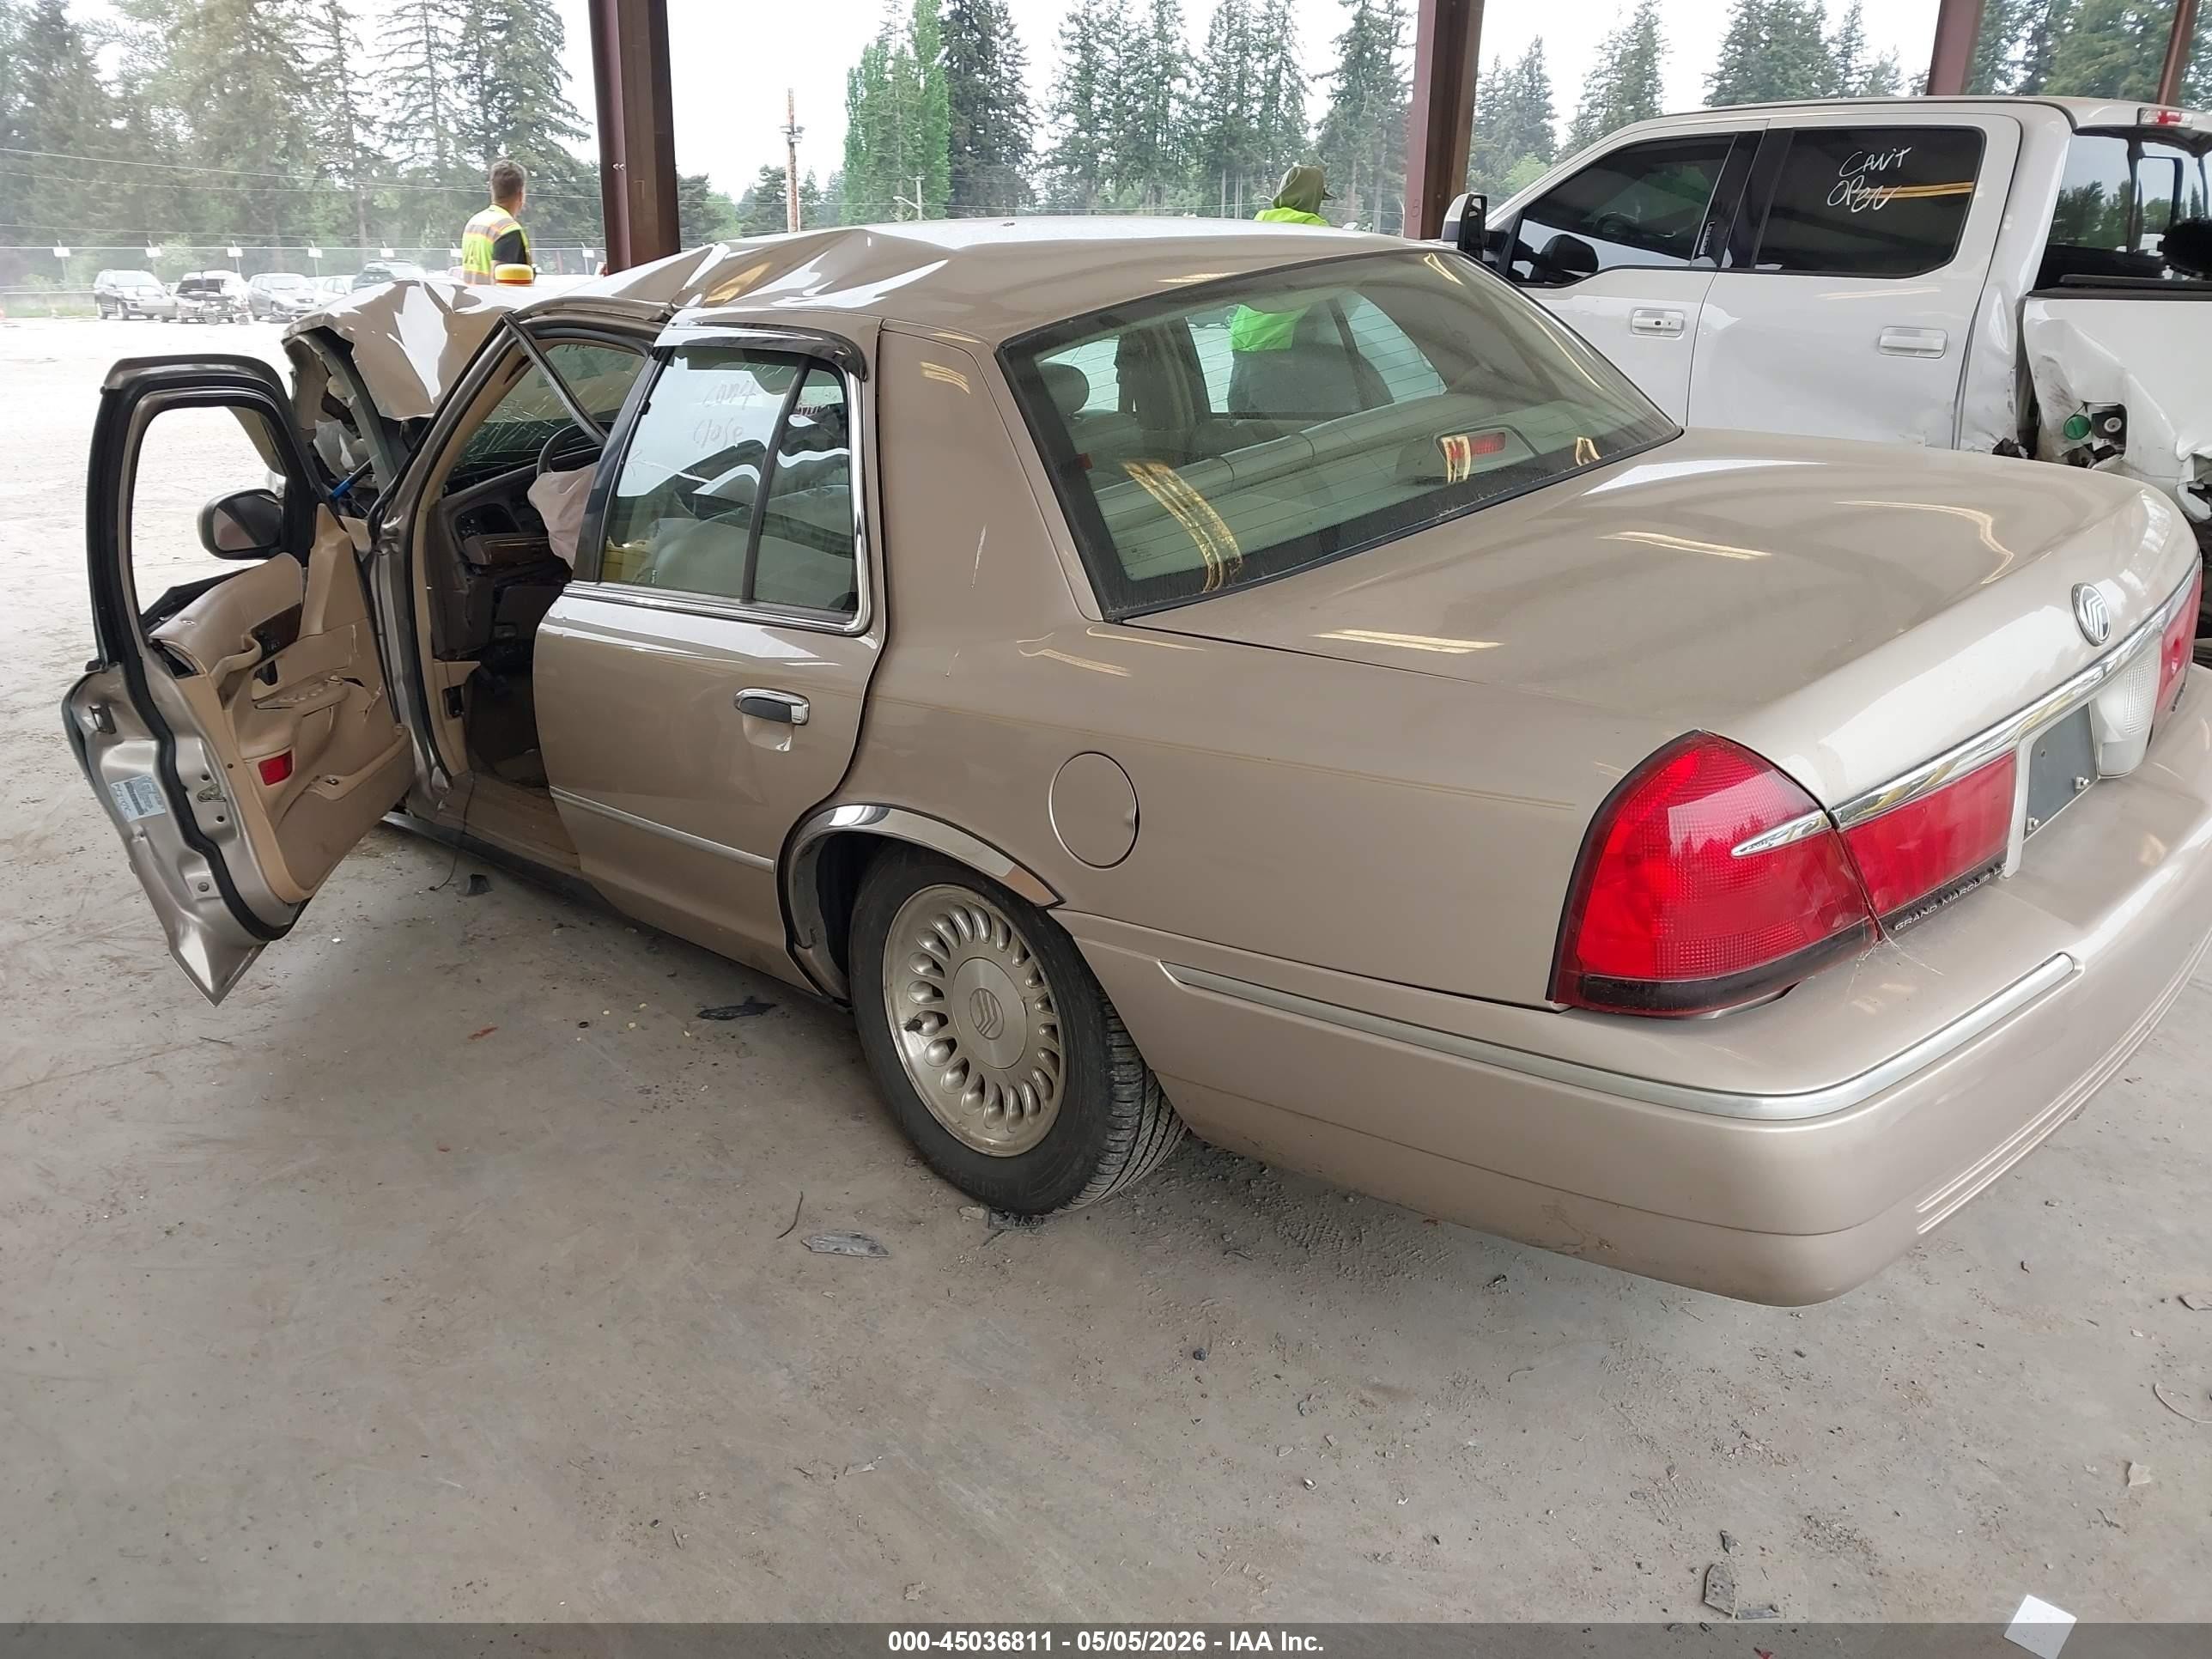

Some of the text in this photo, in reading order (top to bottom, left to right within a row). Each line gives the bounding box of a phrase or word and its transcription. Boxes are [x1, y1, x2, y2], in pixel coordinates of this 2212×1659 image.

[1839, 147, 1912, 177] CAN'T
[1827, 175, 1902, 213] OPEN
[1894, 903, 1938, 932] GRAND
[1942, 872, 1991, 907] MARQUIS
